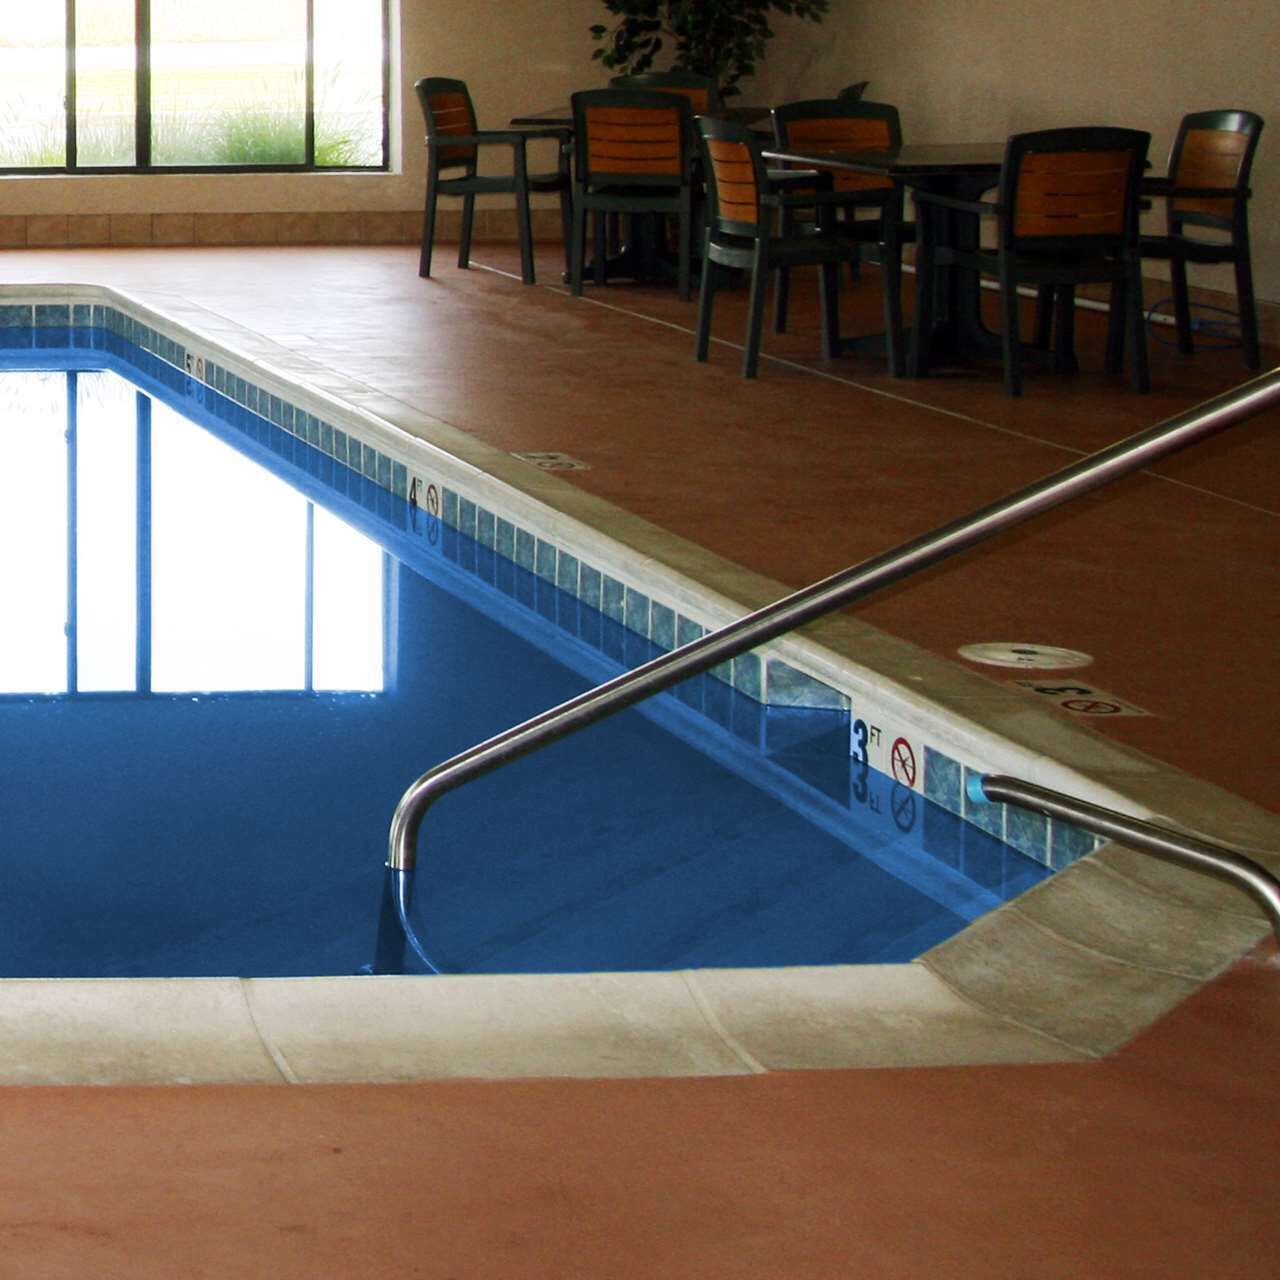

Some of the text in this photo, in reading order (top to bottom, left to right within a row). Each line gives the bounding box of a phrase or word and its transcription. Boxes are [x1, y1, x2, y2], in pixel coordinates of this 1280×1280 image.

[409, 476, 418, 507] 4
[852, 719, 882, 764] 3 FT
